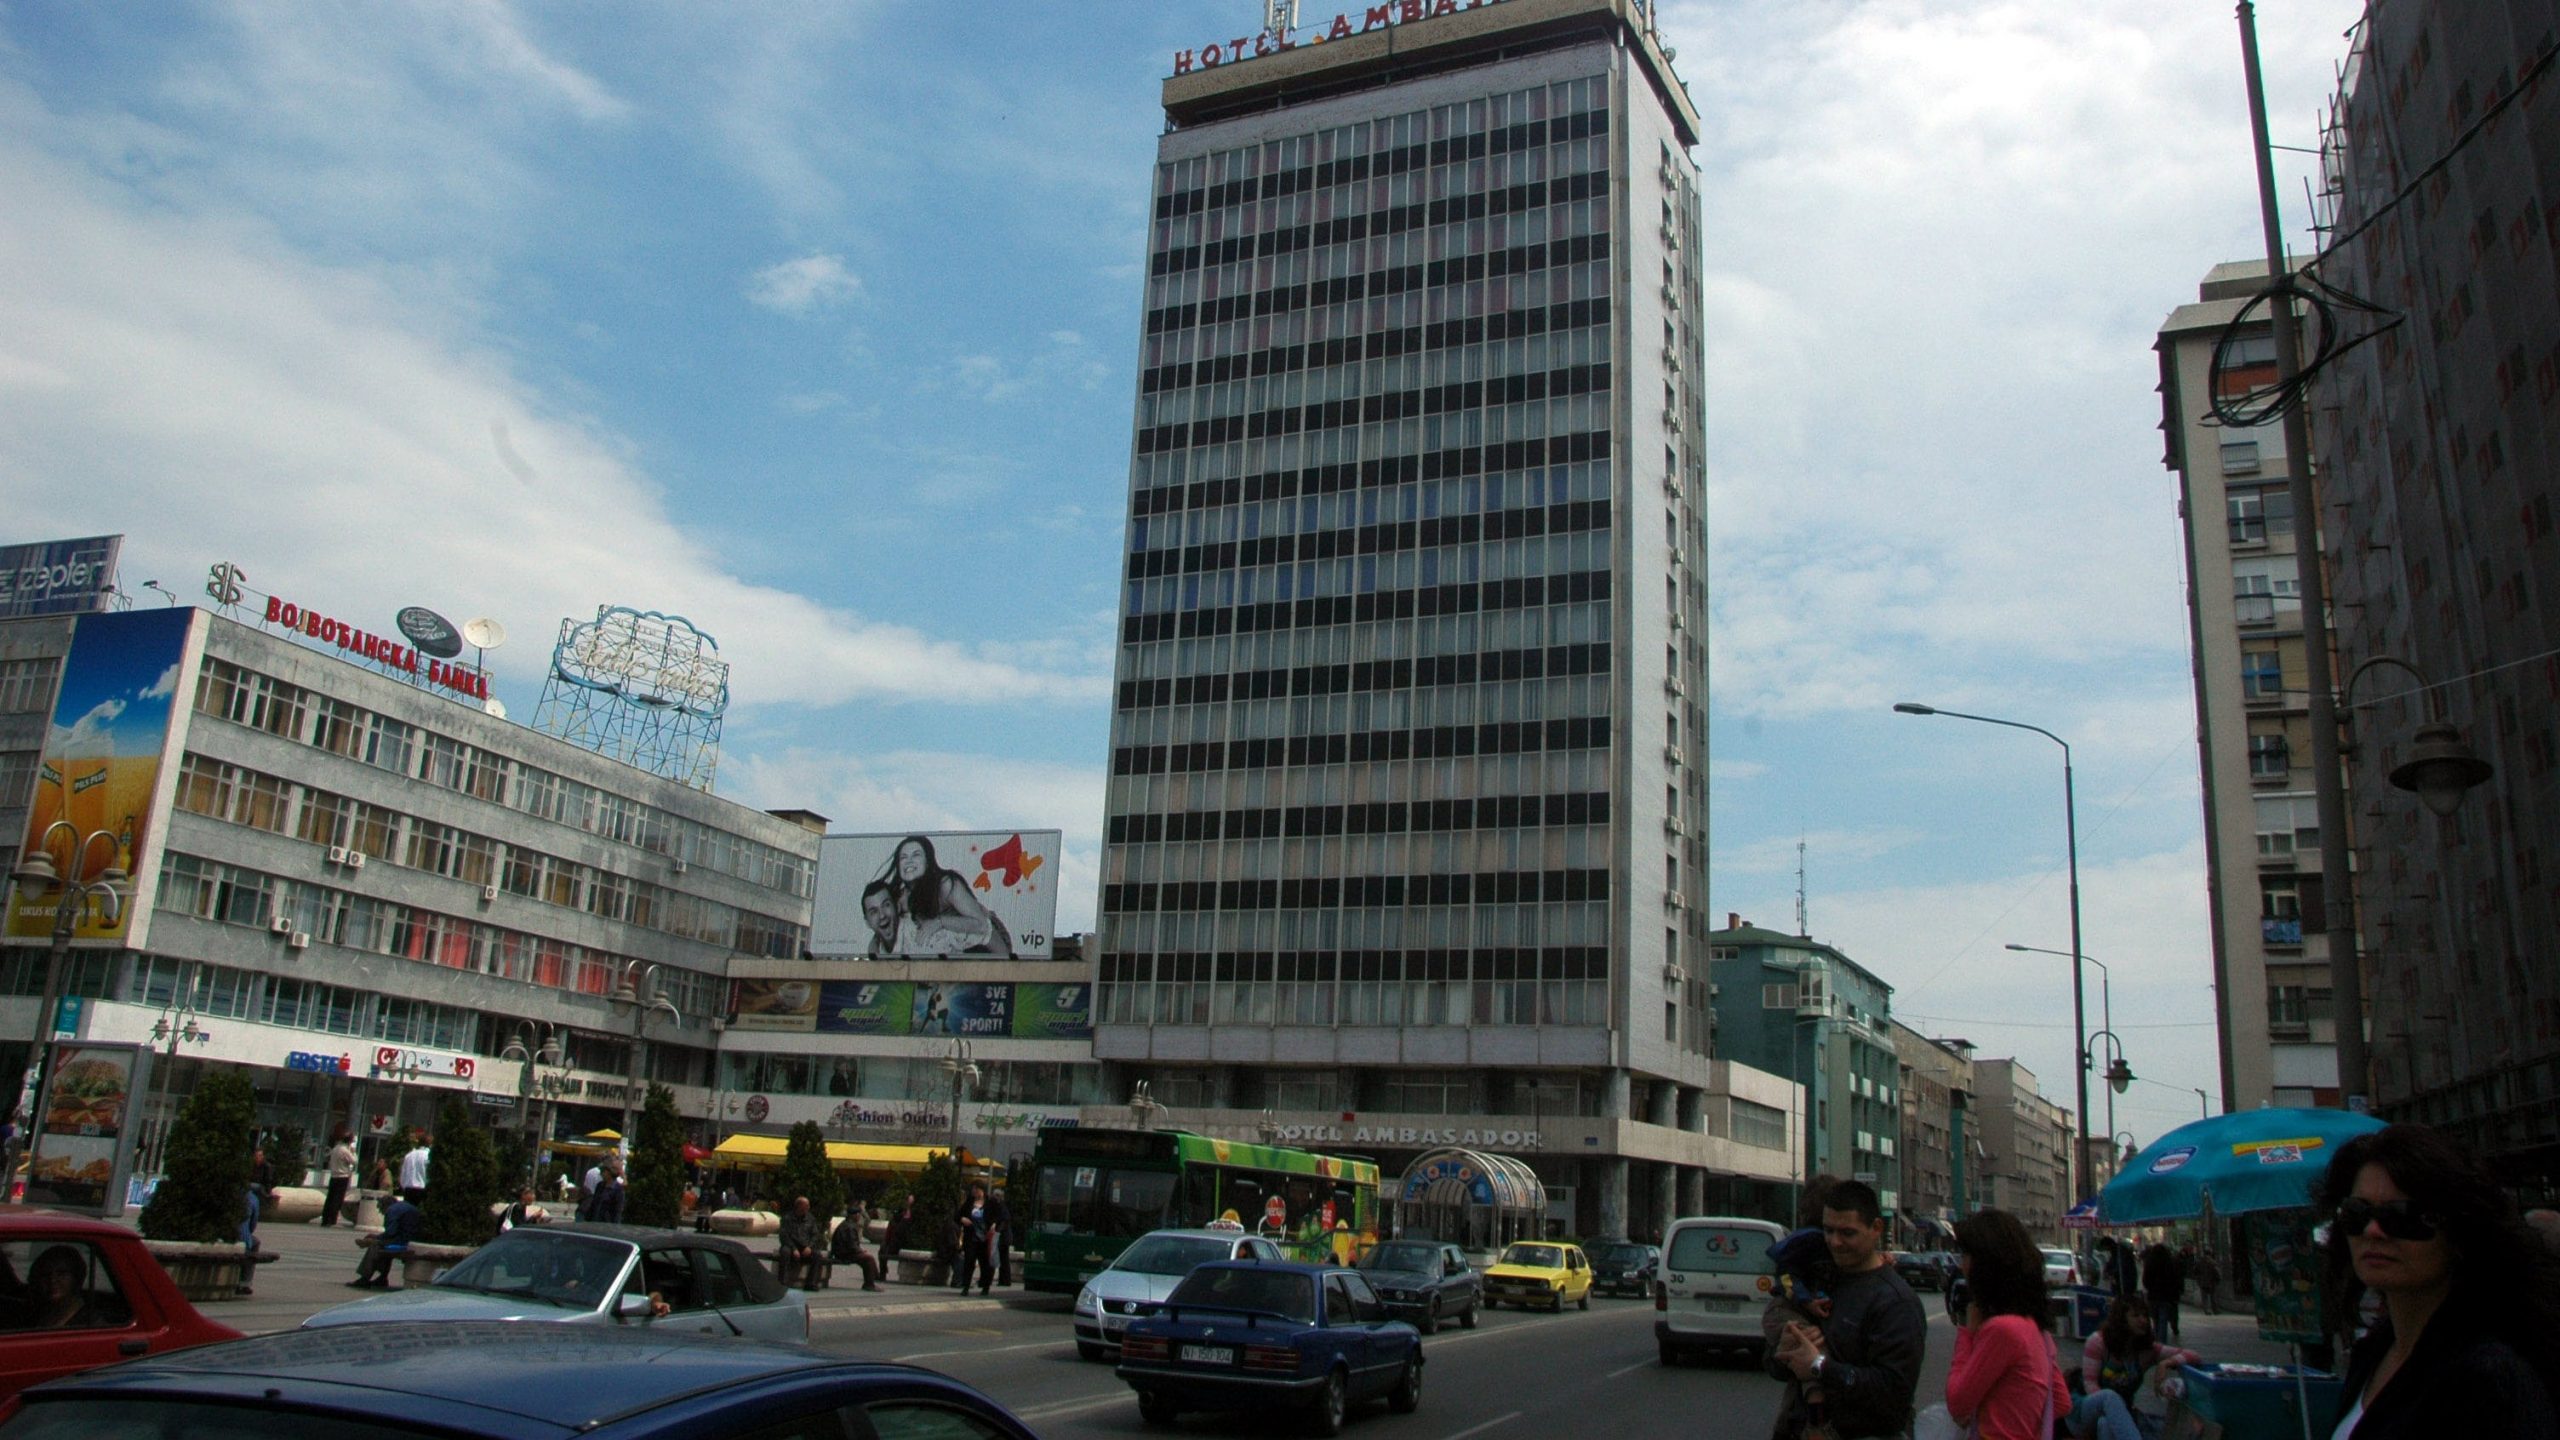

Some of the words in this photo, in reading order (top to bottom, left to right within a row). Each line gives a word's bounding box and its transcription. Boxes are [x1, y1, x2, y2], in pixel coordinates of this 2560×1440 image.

[1174, 28, 1296, 77] HOTEL
[20, 551, 106, 600] zepter
[429, 658, 487, 700] БАНКА
[1021, 929, 1045, 949] vip
[985, 986, 1008, 999] SVE
[989, 1002, 1005, 1015] ZA
[960, 1017, 1004, 1032] SPORT!
[289, 1051, 339, 1073] ERSTE
[420, 1055, 433, 1069] vip
[1353, 1126, 1544, 1148] AMBASADOR
[1670, 1274, 1685, 1283] 30
